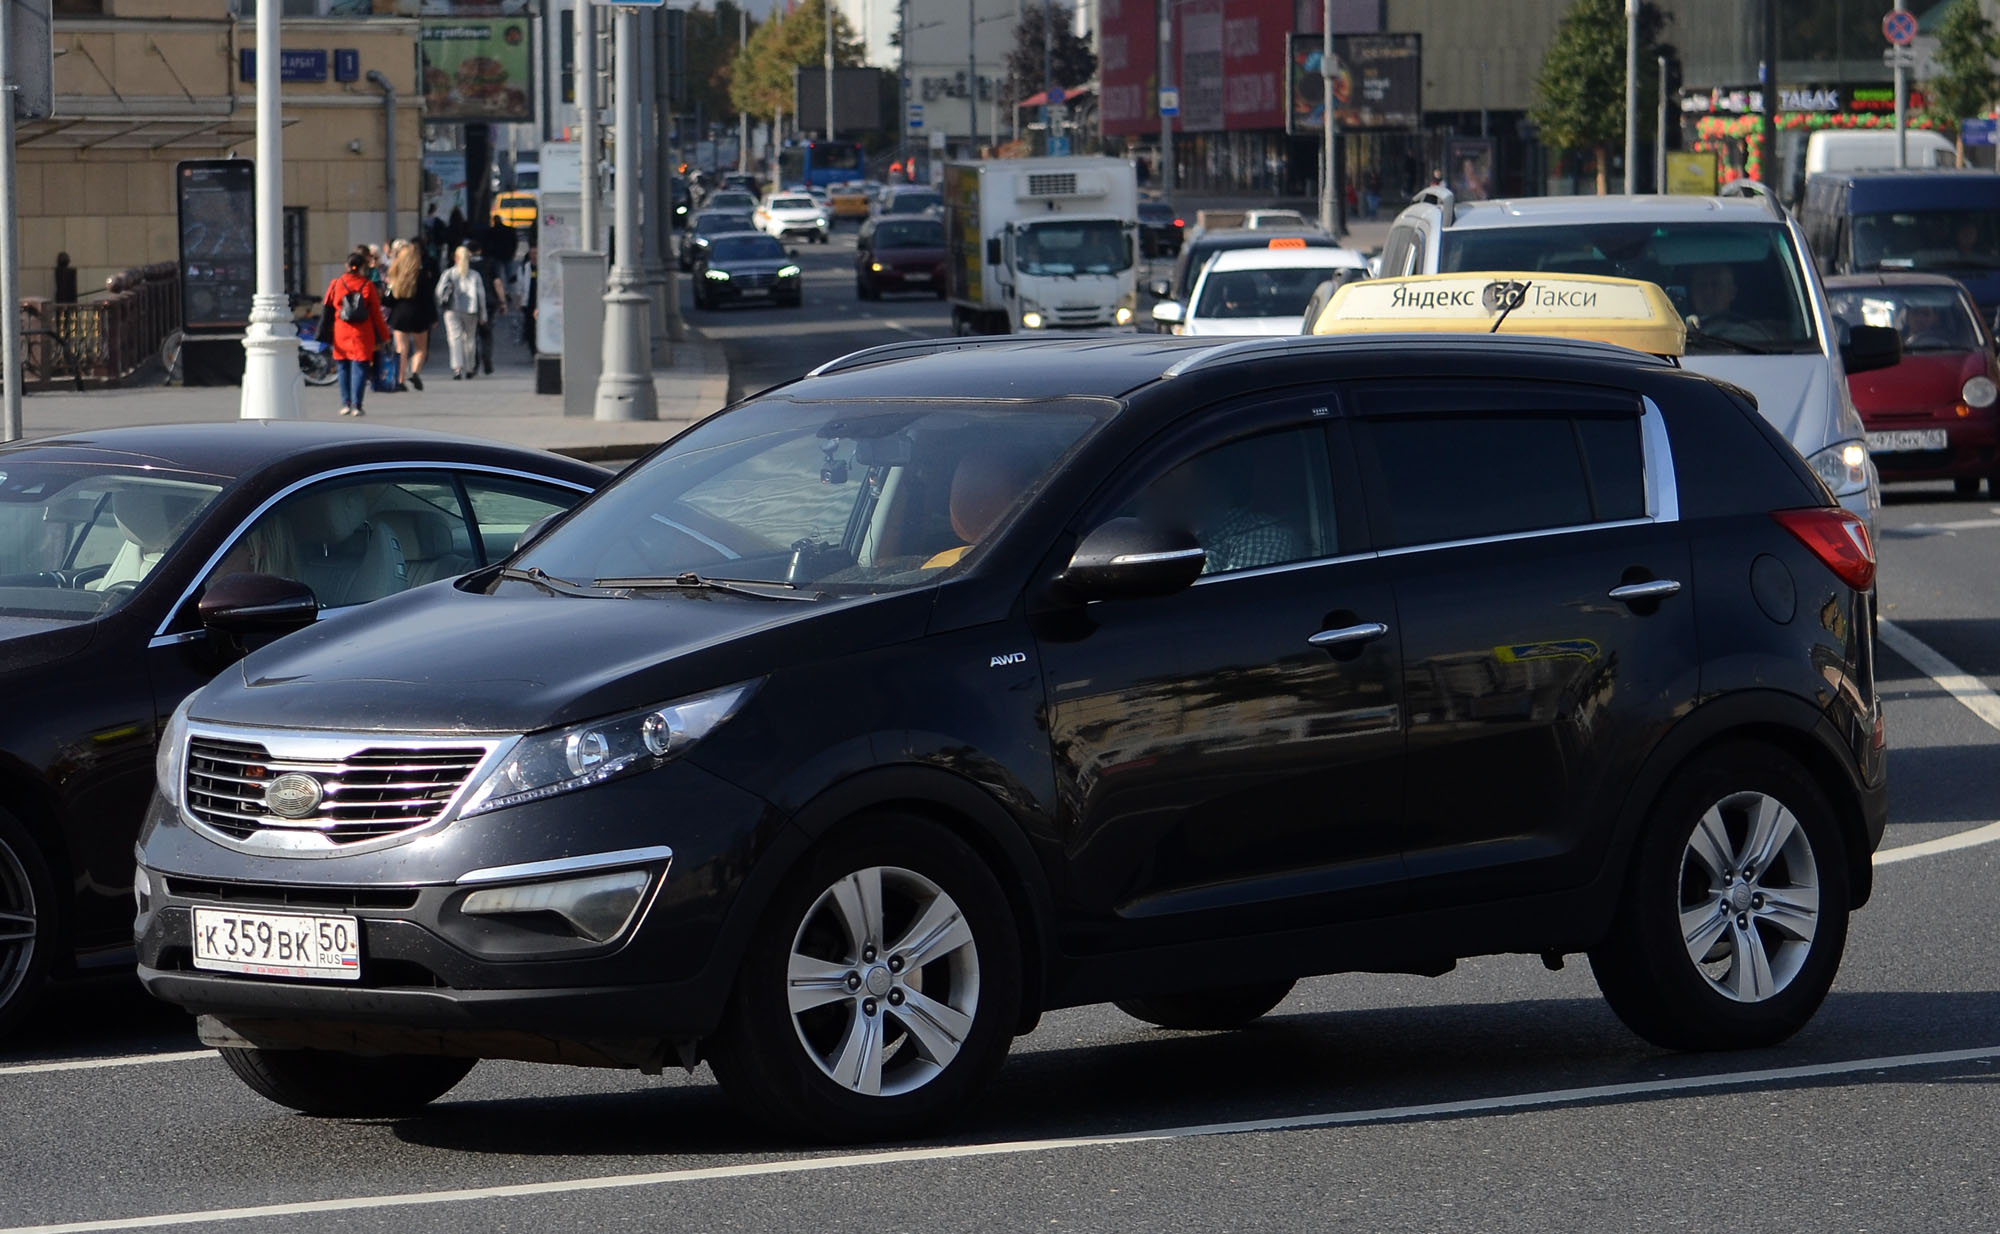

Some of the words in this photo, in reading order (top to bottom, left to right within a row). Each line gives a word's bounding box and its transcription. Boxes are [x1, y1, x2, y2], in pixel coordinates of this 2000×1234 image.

[346, 55, 353, 71] 1
[1778, 89, 1839, 111] ТАБАК
[1391, 286, 1475, 309] Яндекс
[1533, 285, 1597, 307] Такси
[990, 651, 1026, 668] AWD
[319, 922, 348, 952] 50
[319, 953, 341, 965] RUS
